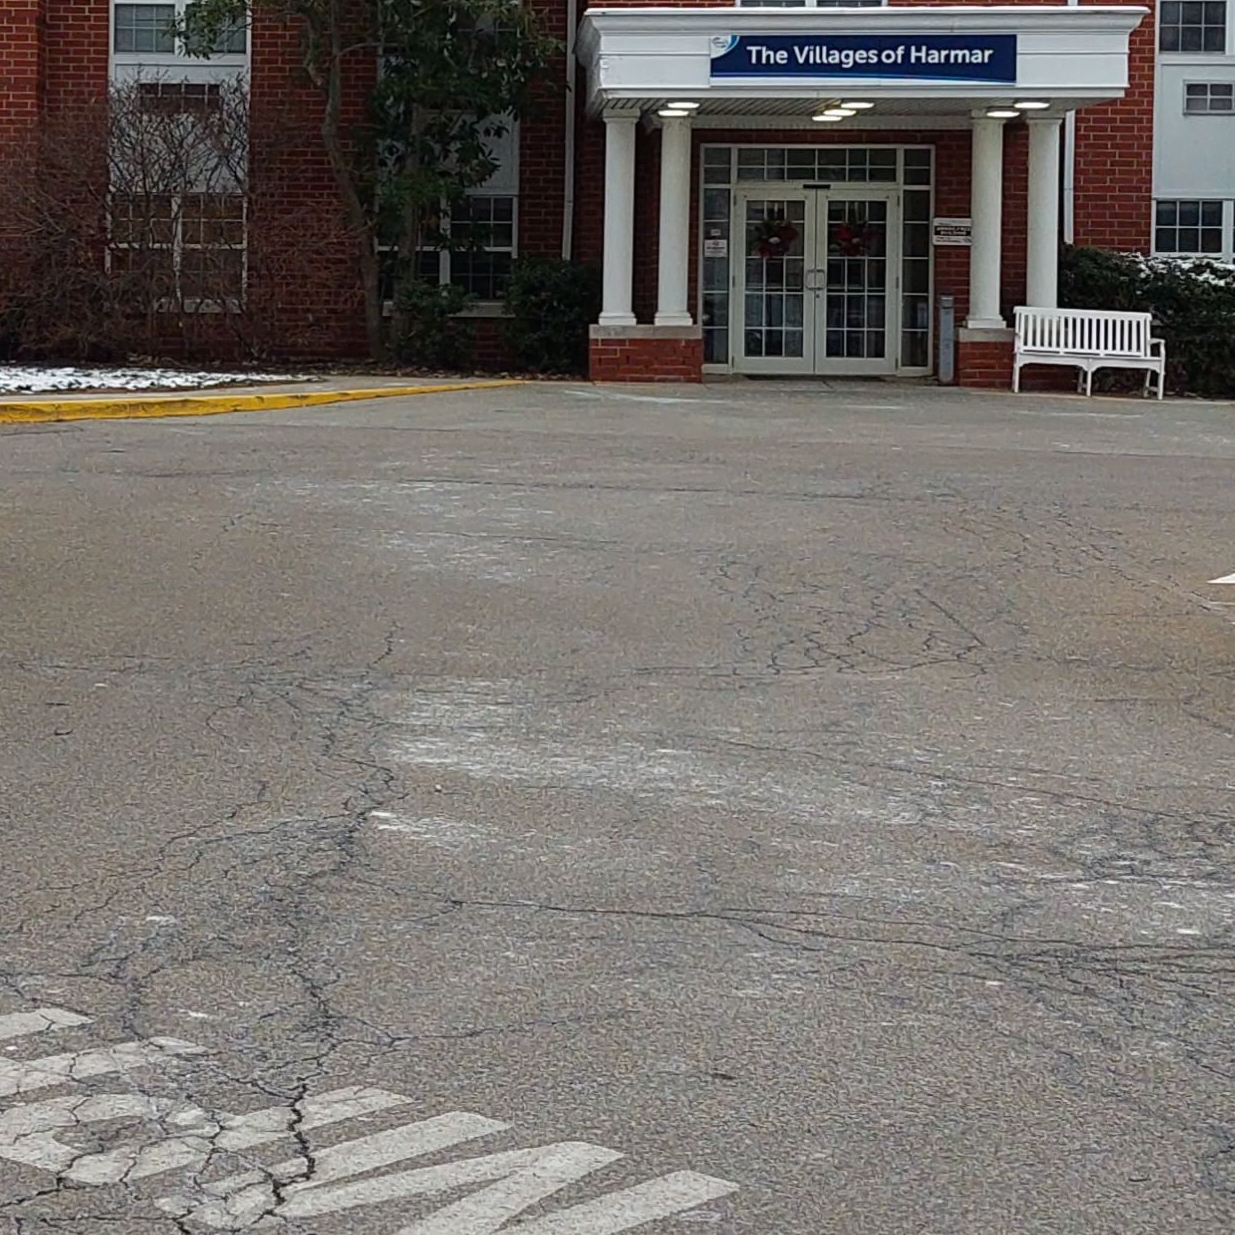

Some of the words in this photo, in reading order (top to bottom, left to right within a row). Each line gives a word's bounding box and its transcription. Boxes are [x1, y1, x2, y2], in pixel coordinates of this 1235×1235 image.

[746, 45, 788, 64] The
[793, 45, 879, 68] Villages
[882, 45, 906, 64] of
[910, 46, 994, 64] Harmar
